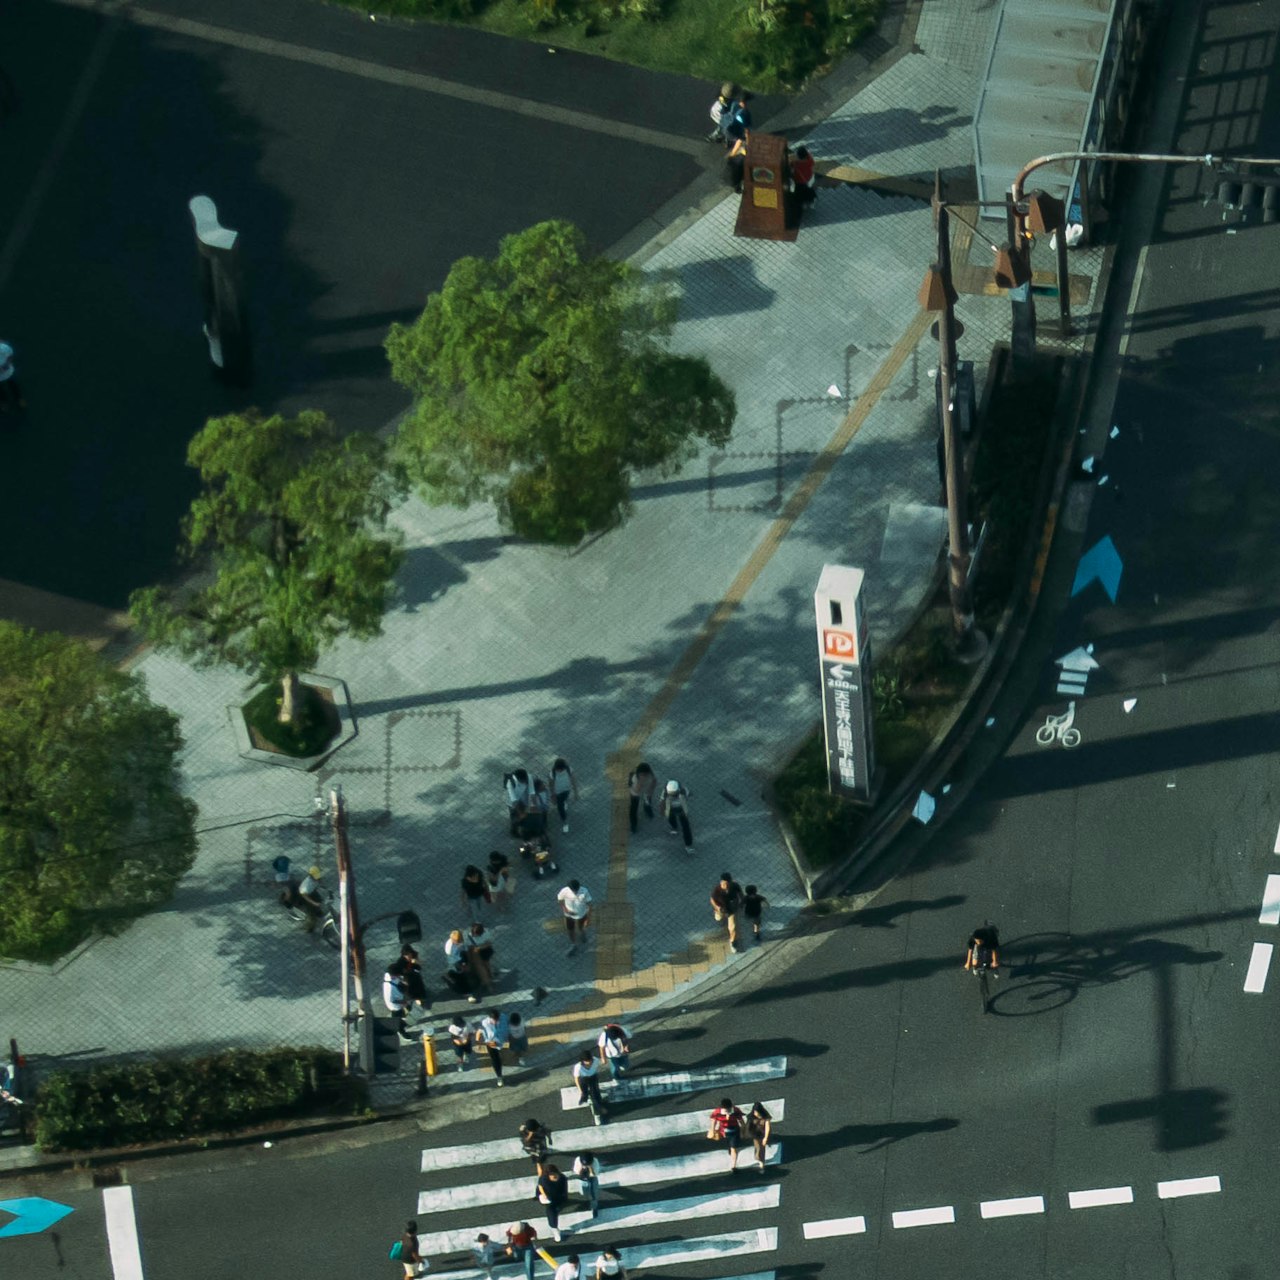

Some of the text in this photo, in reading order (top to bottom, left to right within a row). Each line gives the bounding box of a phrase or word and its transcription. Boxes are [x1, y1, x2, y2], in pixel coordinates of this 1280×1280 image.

[827, 678, 858, 692] 200m
[834, 689, 856, 788] 天王寺公園地下駐車場
